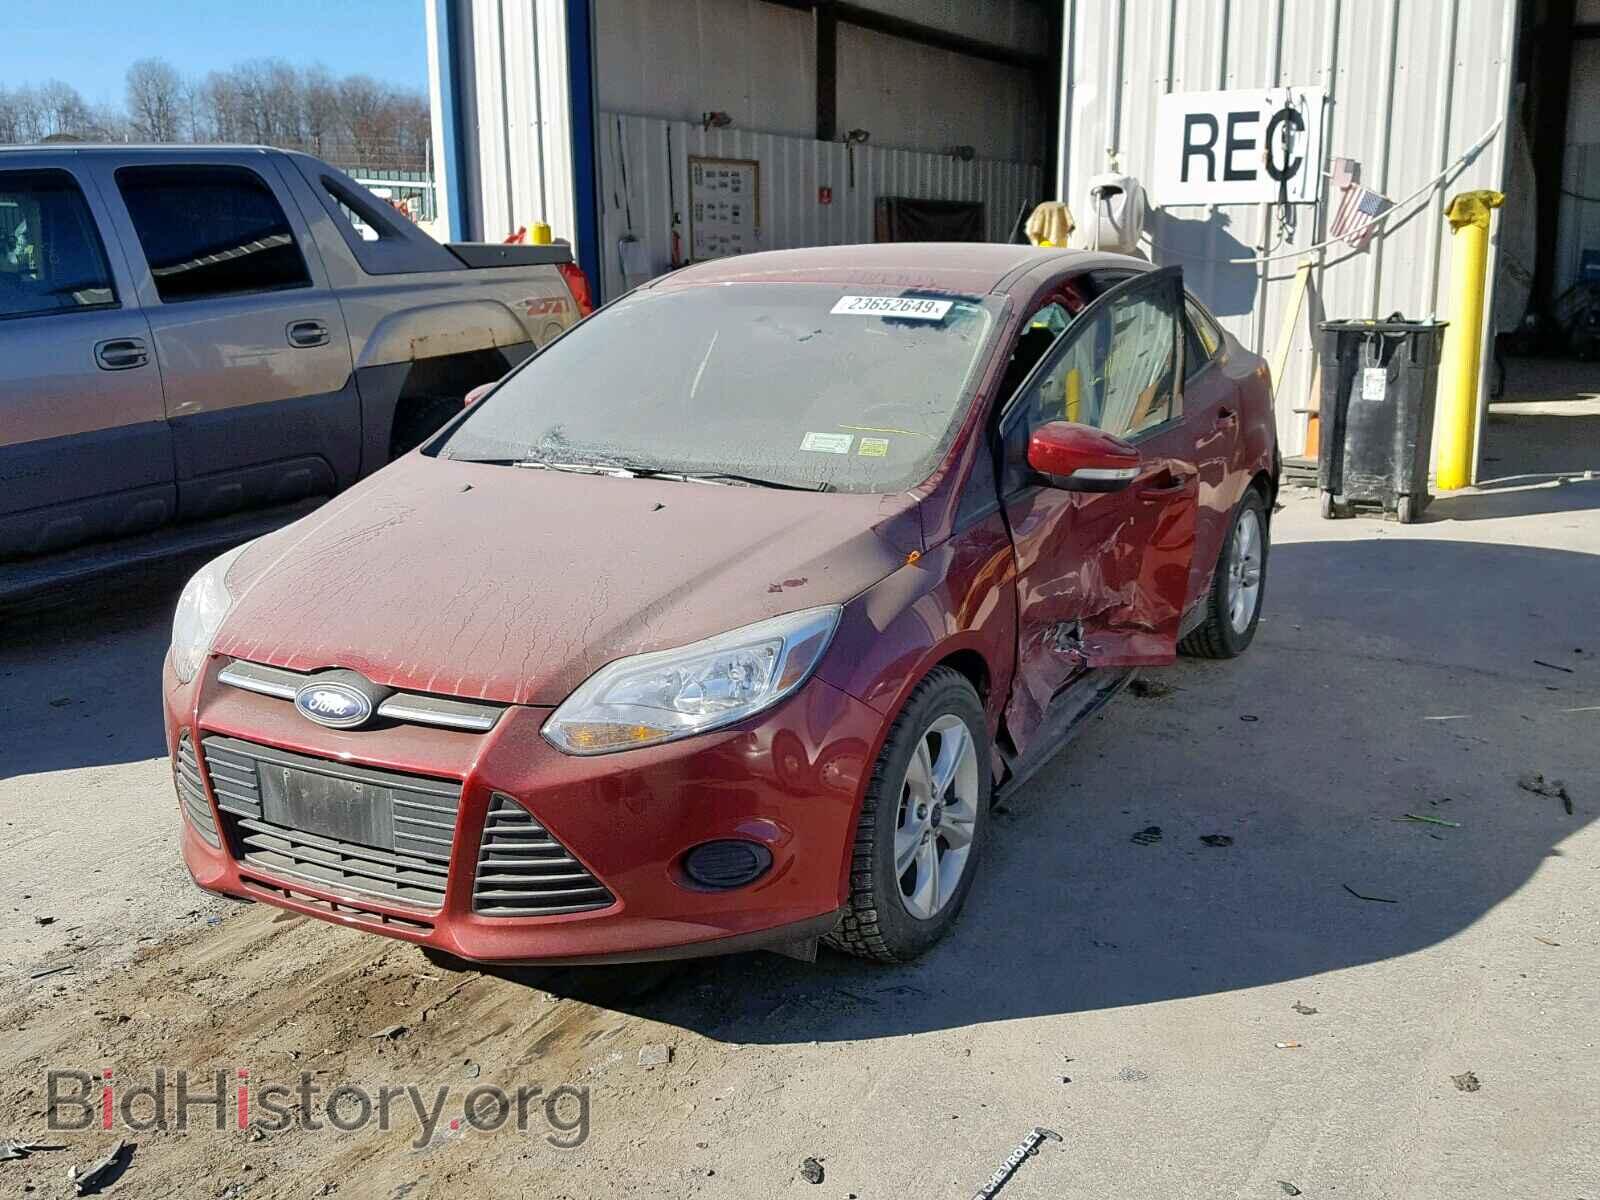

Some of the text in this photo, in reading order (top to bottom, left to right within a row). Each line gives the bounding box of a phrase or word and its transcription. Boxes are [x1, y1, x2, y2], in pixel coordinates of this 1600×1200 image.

[1181, 108, 1305, 183] REC
[309, 691, 351, 715] Ford
[983, 1129, 1040, 1192] CHEVROLET
